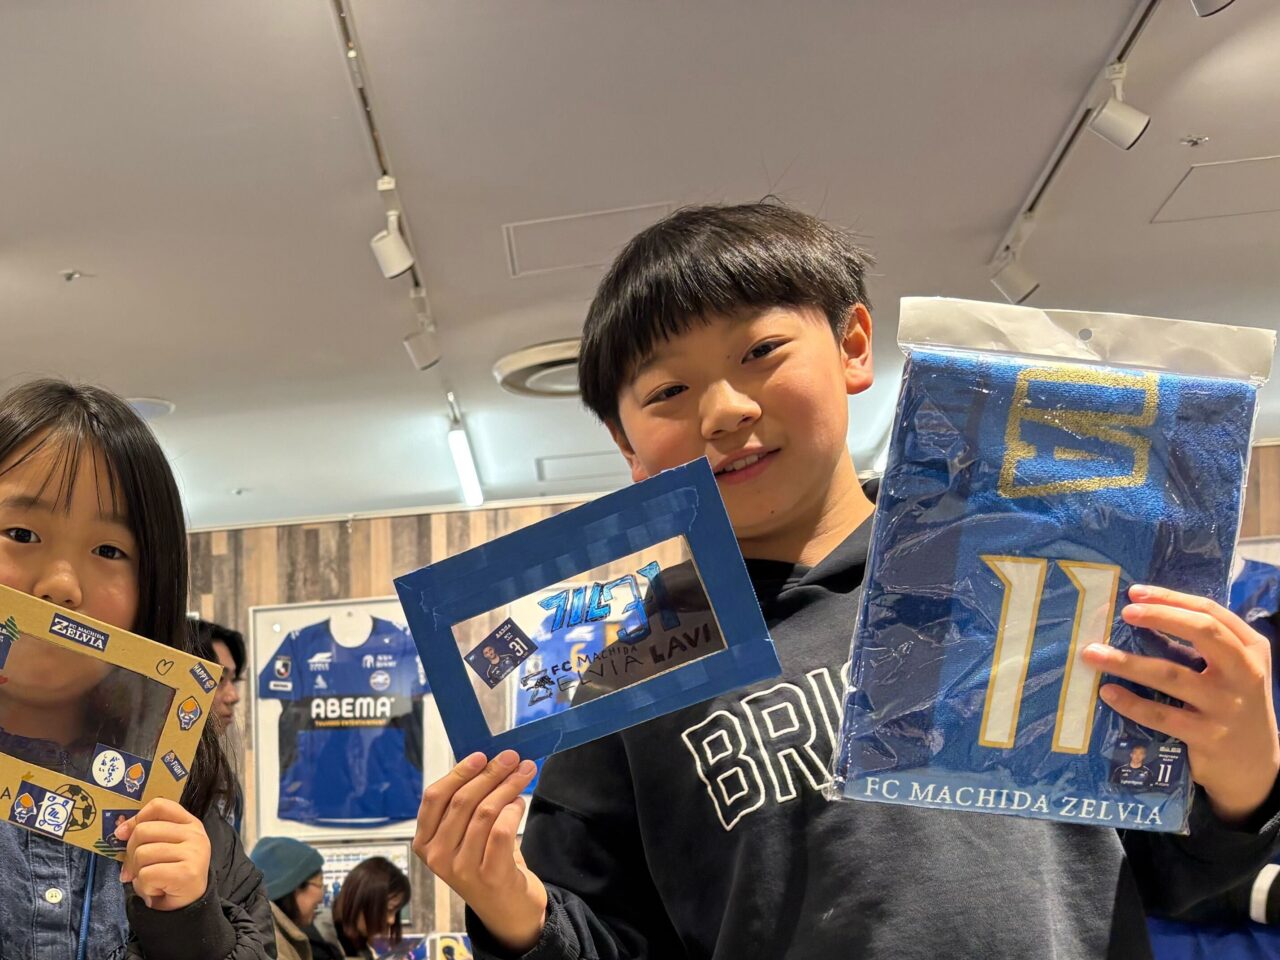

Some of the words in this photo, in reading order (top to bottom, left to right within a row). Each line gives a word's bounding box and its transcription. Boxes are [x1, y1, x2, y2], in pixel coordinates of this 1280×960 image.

[51, 617, 104, 649] ZELVIA
[649, 623, 712, 665] LAVI
[551, 662, 572, 676] FC
[577, 645, 638, 667] MACHIDA
[978, 554, 1121, 754] 11
[311, 697, 392, 719] ABEMA
[681, 662, 852, 832] BRI
[170, 760, 186, 777] FIGHT
[863, 776, 901, 800] FC
[907, 781, 1050, 813] MACHIDA
[1059, 796, 1163, 825] ZELVIA
